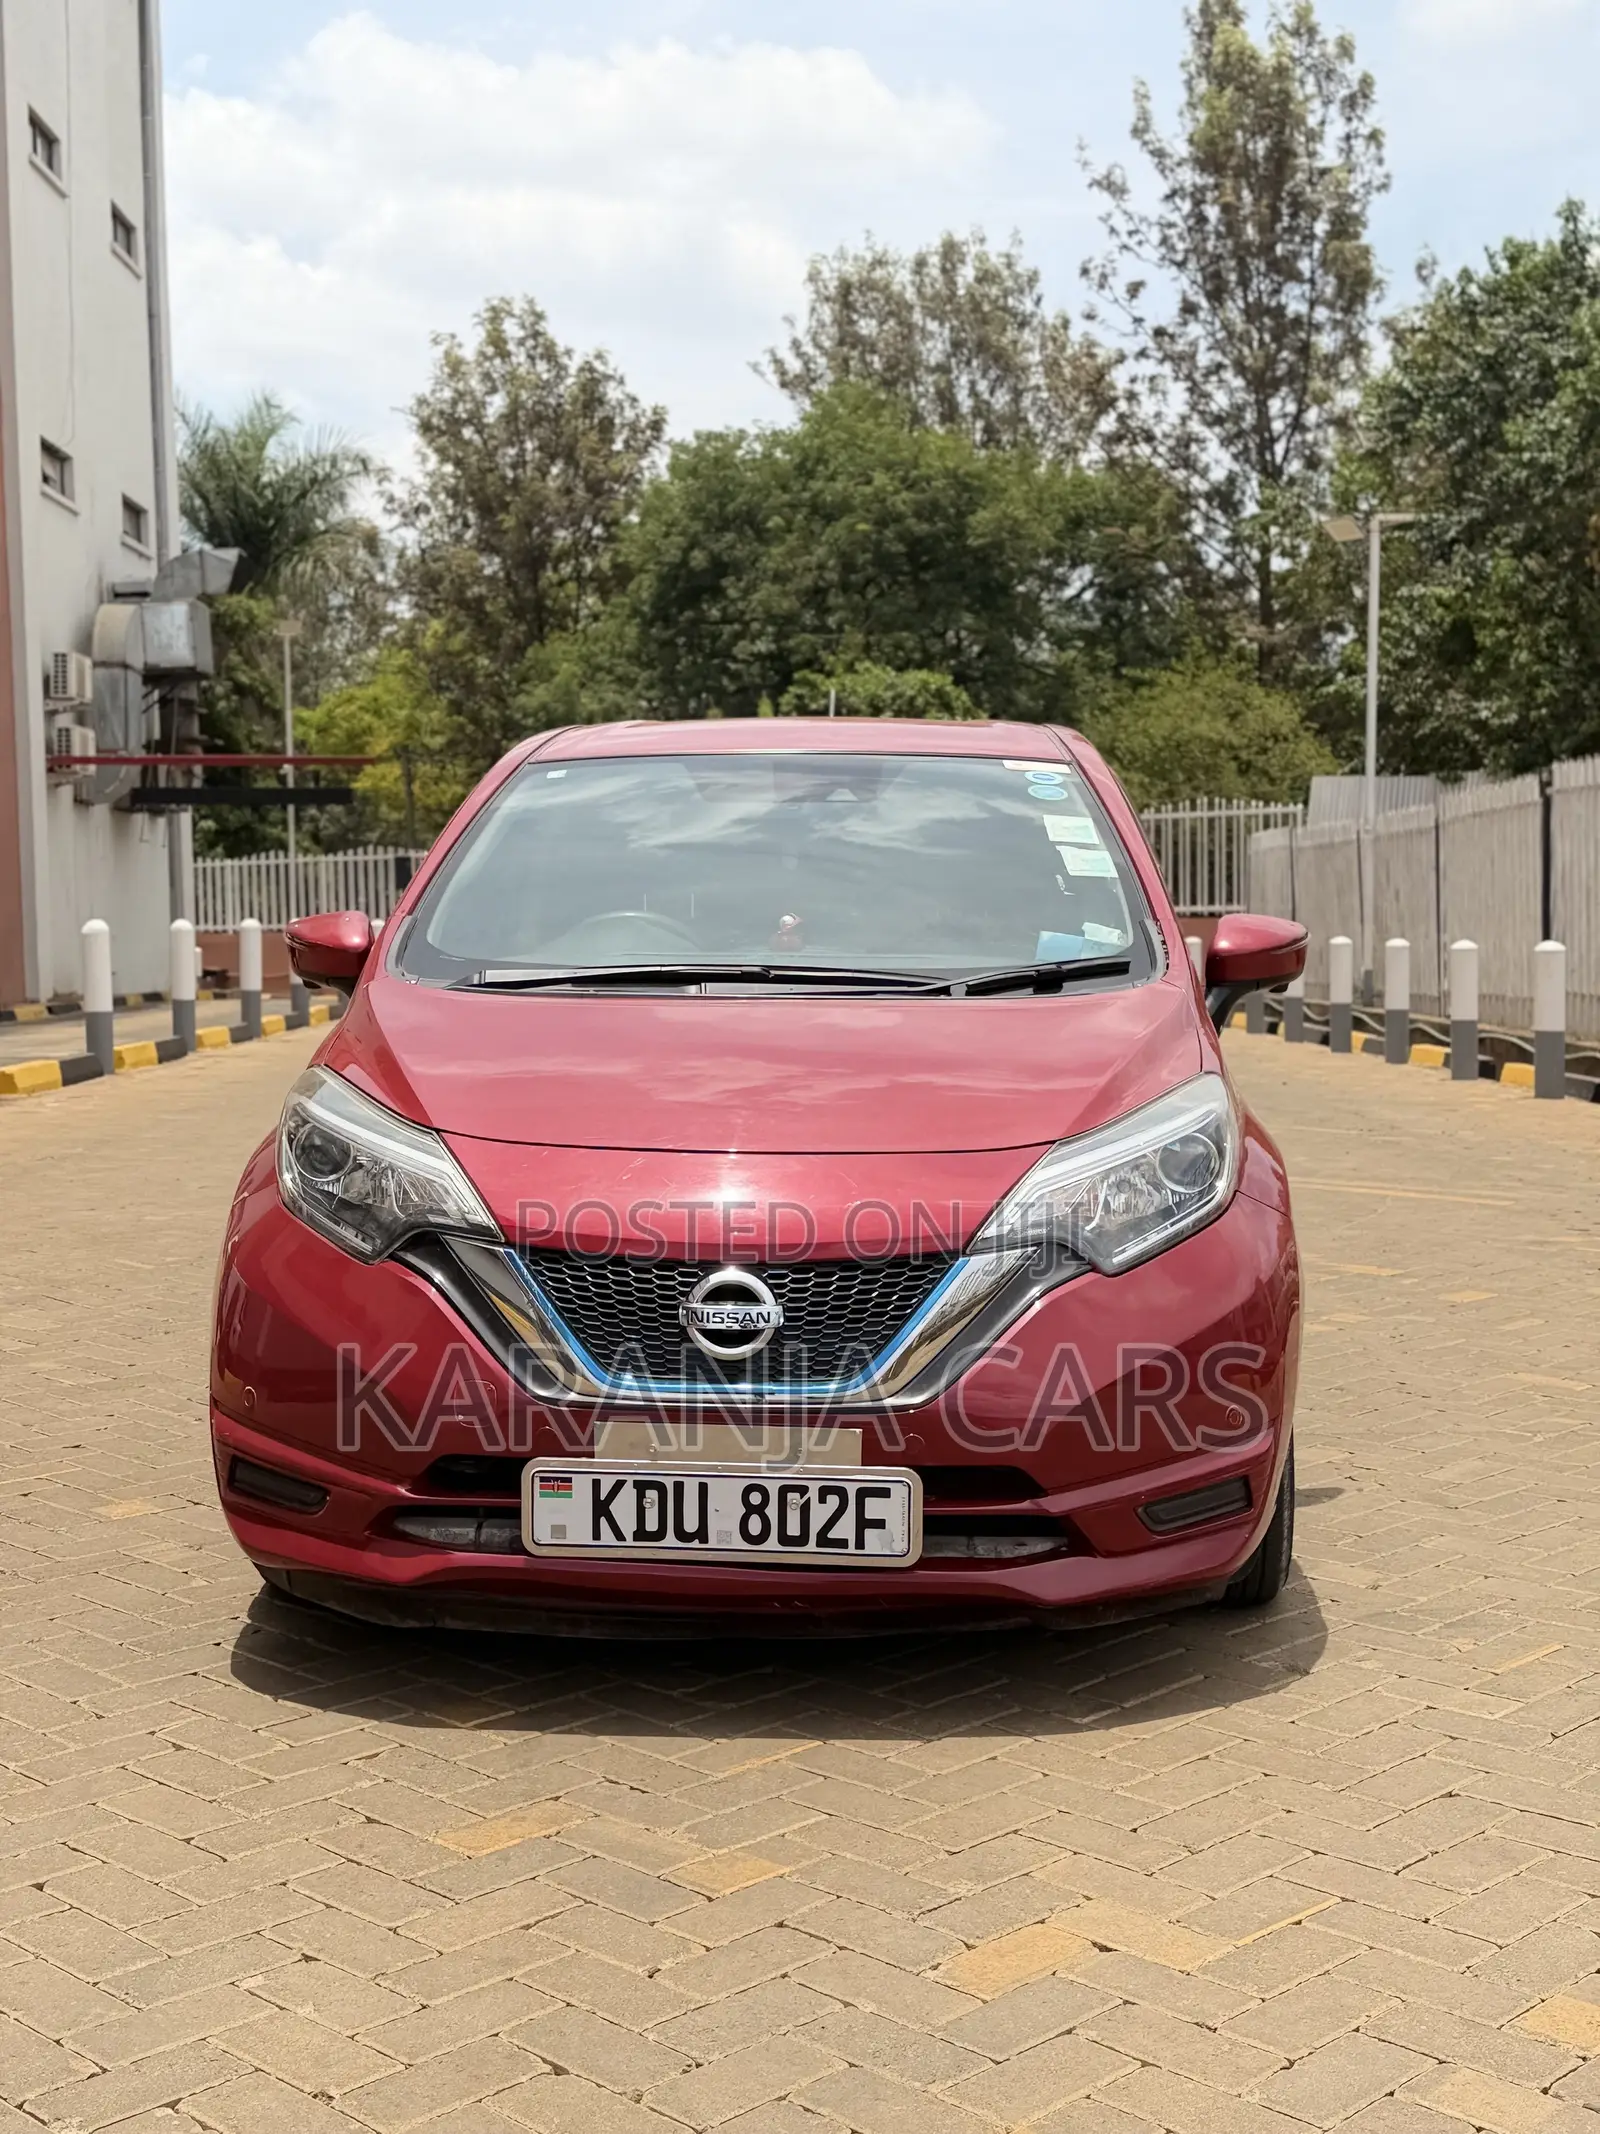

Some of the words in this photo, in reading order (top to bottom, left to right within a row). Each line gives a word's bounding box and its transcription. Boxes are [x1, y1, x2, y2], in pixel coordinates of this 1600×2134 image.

[689, 1310, 771, 1325] NISSAN
[591, 1478, 709, 1544] KDU
[738, 1483, 892, 1550] 802F
